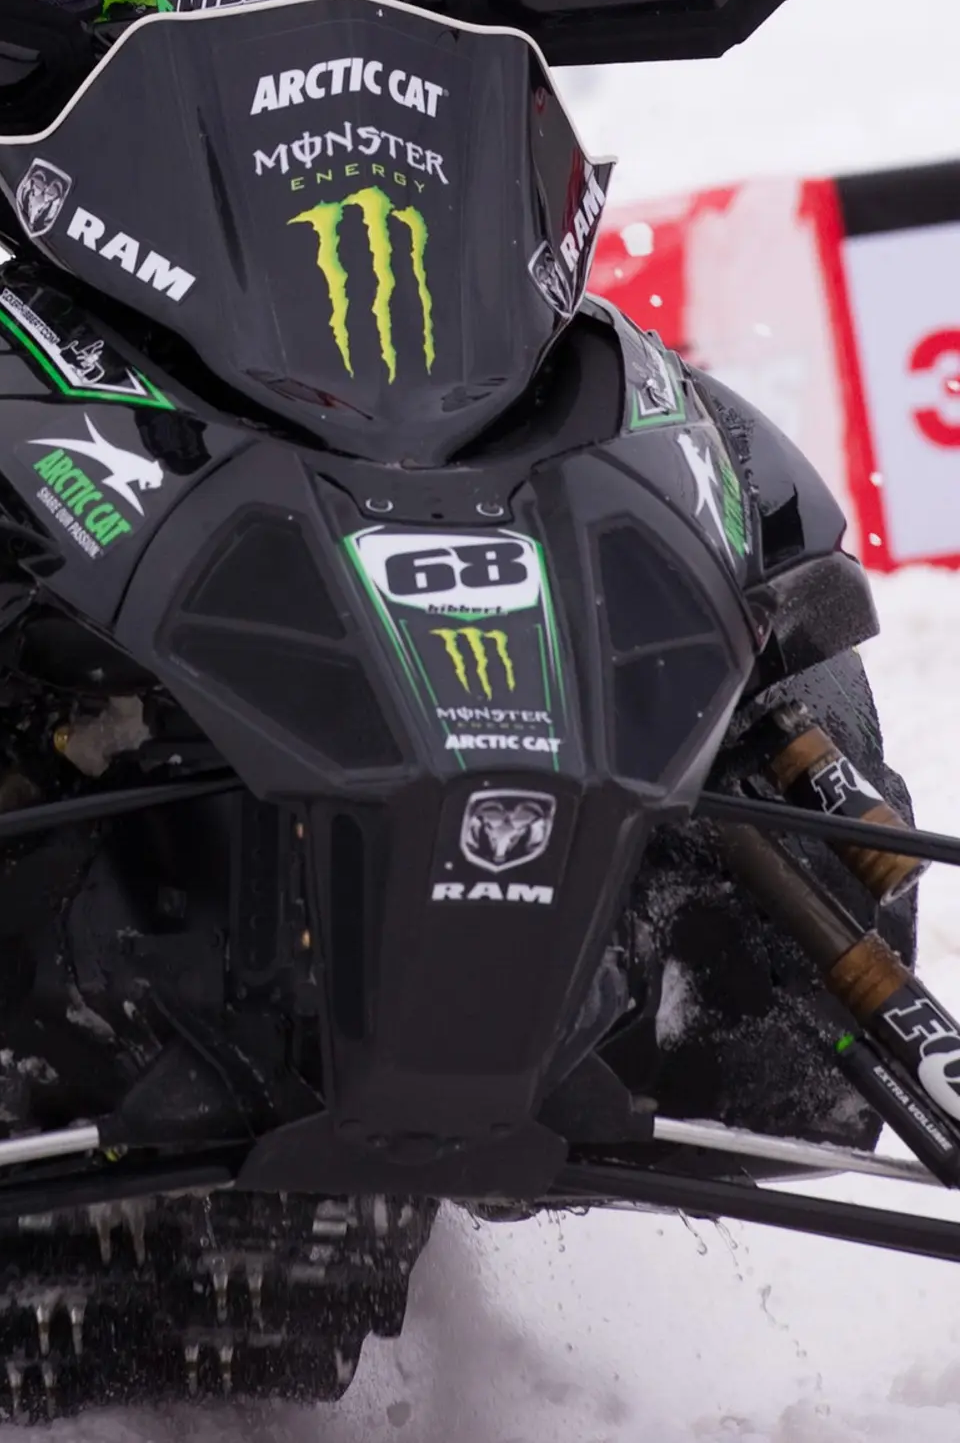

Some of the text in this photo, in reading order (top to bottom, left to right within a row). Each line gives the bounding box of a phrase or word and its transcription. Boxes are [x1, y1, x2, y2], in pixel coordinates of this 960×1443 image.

[250, 57, 444, 118] ARCTIC CAT
[252, 121, 450, 185] MONSTER
[291, 163, 425, 193] ENERGY
[560, 159, 606, 273] RAM
[67, 206, 196, 302] RAM
[908, 328, 960, 448] 3
[33, 448, 103, 516] ARCTIC
[85, 502, 132, 546] CAT
[385, 542, 528, 596] 68
[436, 706, 552, 724] MONSTER
[444, 734, 561, 753] ARCTIC CAT
[432, 882, 553, 905] RAM
[873, 1065, 953, 1152] EXTRA VOLUME
